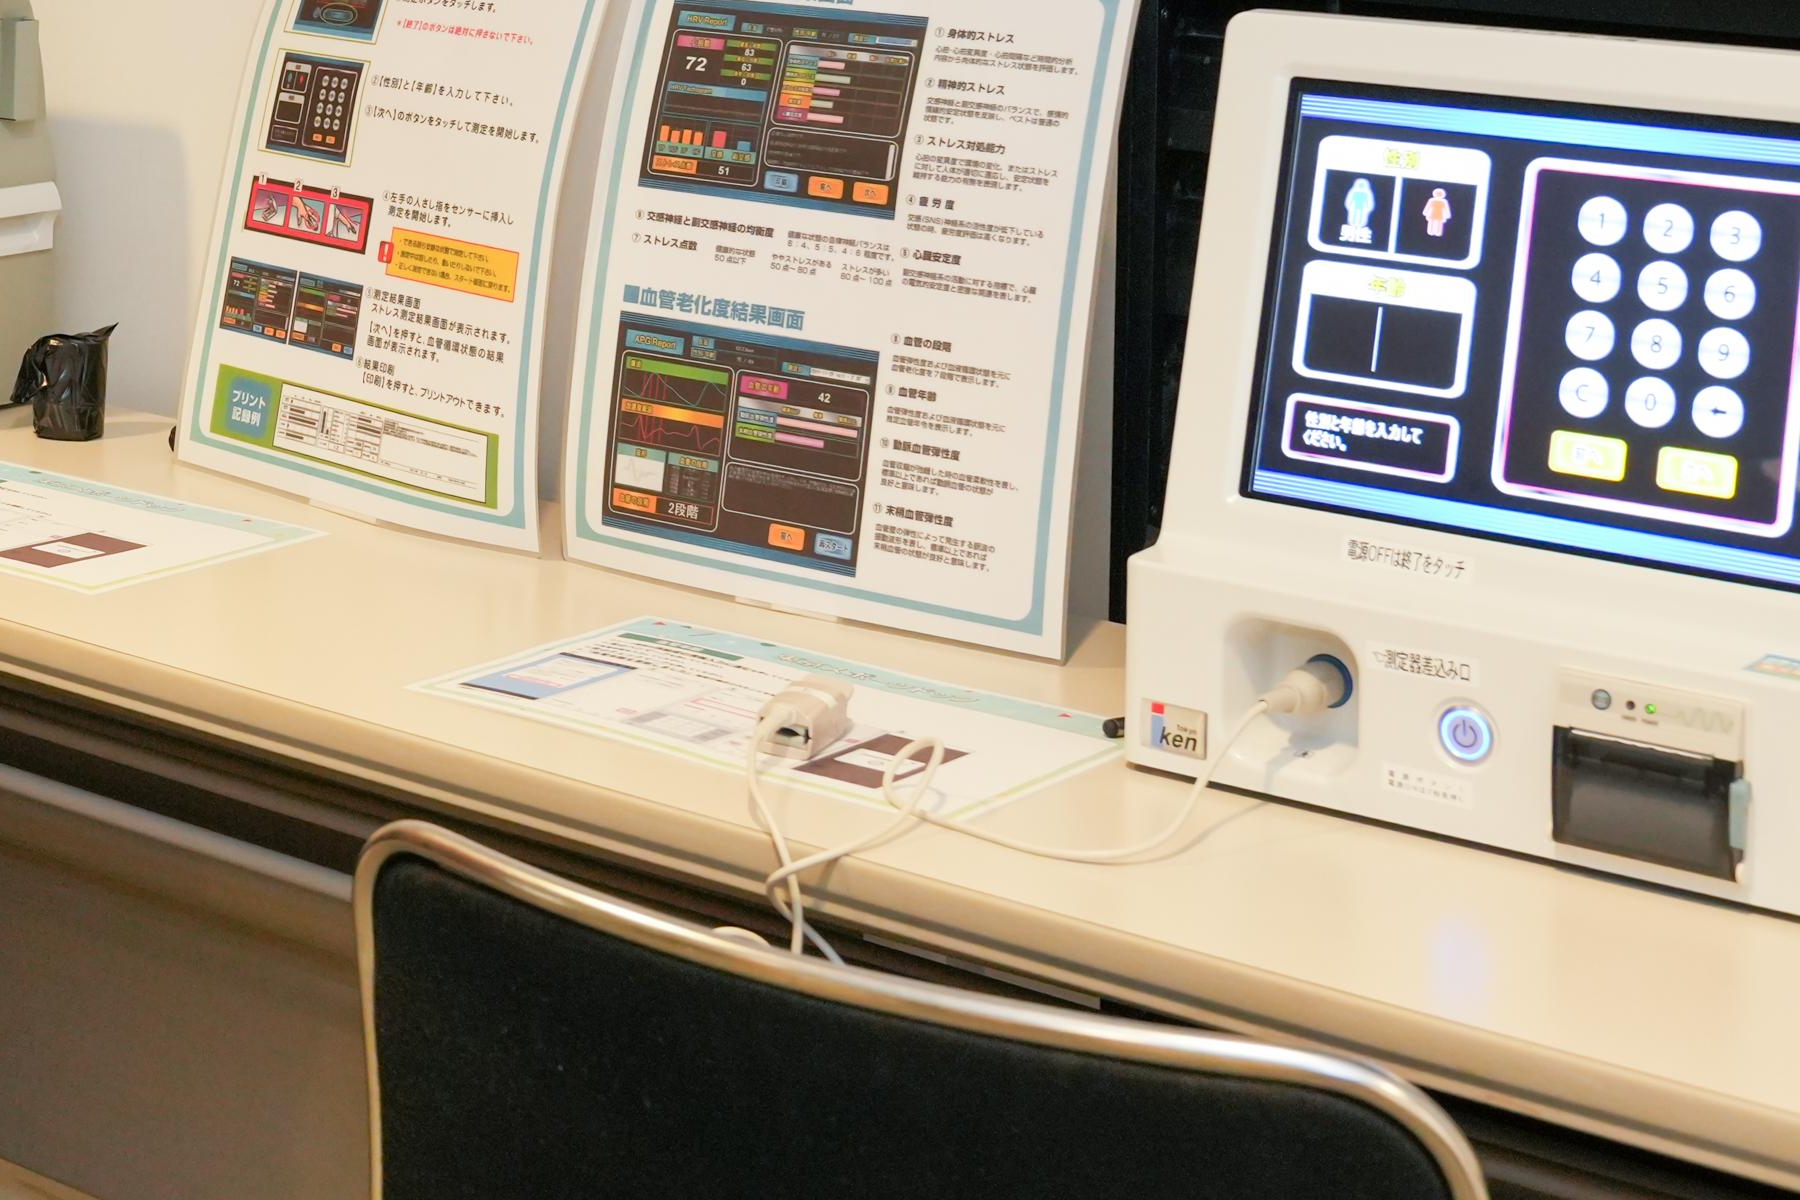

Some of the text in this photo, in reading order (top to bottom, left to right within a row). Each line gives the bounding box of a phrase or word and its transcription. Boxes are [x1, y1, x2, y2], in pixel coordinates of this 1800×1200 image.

[947, 28, 1015, 44] 身体的ストレス
[684, 55, 708, 72] 72
[937, 78, 1006, 96] 精神的ストレス
[717, 165, 731, 176] 51
[387, 206, 451, 228] 測定を開始します。
[1338, 223, 1373, 244] 男性
[1663, 219, 1675, 238] 2
[1729, 226, 1741, 245] 3
[643, 234, 698, 251] ストレス点数
[1589, 270, 1736, 304] 4 5 6
[640, 286, 807, 331] 血管老化度結果画面
[1584, 325, 1730, 362] 7 8 9
[231, 388, 267, 409] プリント
[817, 392, 832, 404] 42
[1575, 383, 1590, 403] C
[230, 408, 262, 428] 記録例
[667, 502, 700, 520] 2段階
[1347, 539, 1466, 579] 電源OFFは終了をタッチ
[1384, 648, 1472, 681] 測定器差込み口
